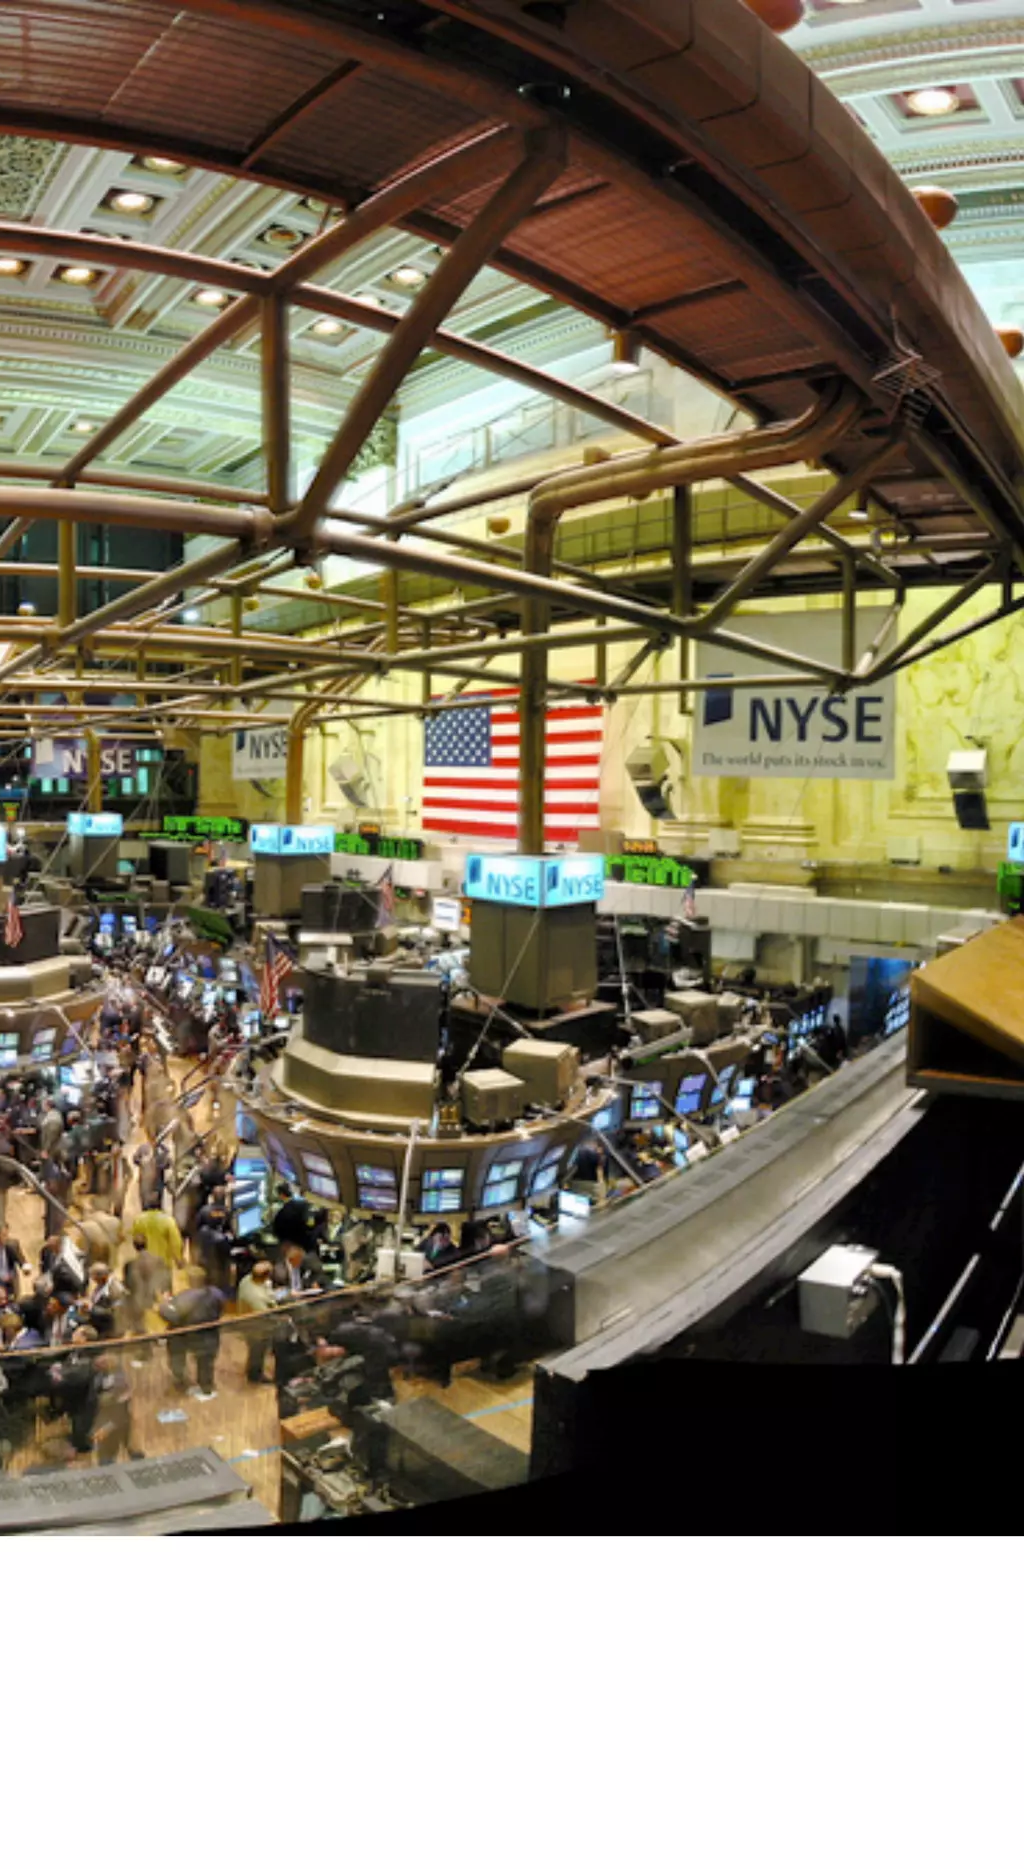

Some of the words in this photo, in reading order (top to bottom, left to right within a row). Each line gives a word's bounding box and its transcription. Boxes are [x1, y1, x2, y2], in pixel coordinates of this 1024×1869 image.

[749, 696, 884, 742] NYSE
[63, 750, 131, 773] NSE
[487, 873, 535, 900] NYSE
[562, 873, 603, 897] NYSE
